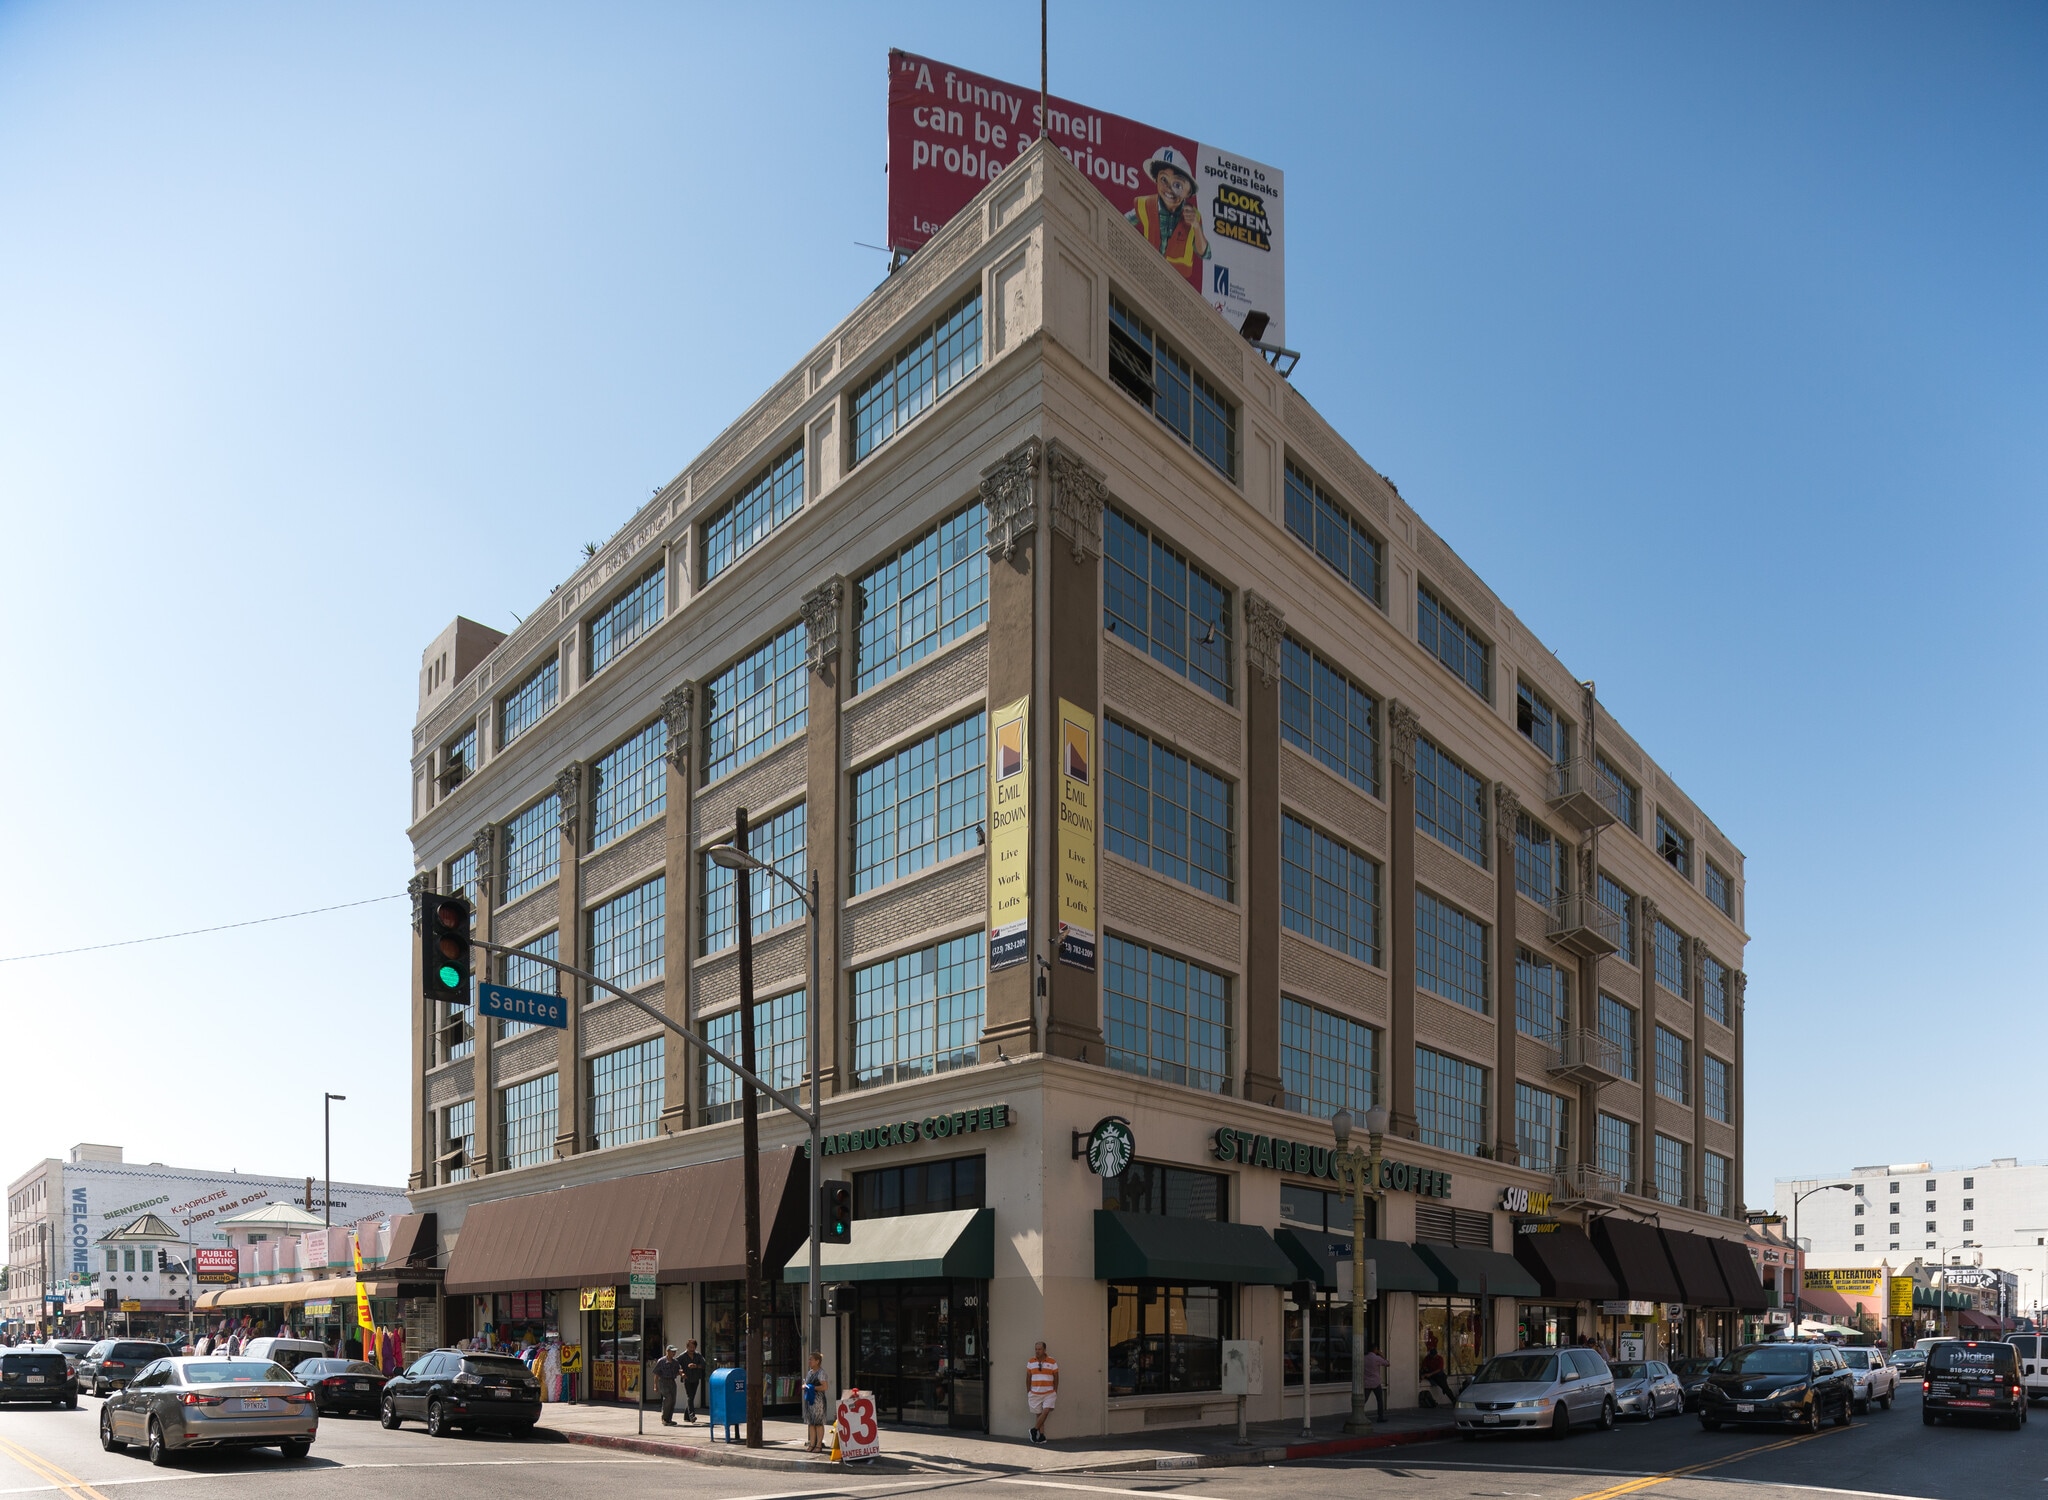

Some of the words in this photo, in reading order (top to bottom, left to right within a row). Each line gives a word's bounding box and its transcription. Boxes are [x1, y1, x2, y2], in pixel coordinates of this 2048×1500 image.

[945, 71, 1022, 125] funny
[1032, 104, 1102, 145] smell
[913, 106, 963, 137] can
[975, 111, 1008, 149] be
[1059, 146, 1140, 190] erious
[913, 139, 1010, 181] proble
[1204, 165, 1228, 180] spot
[1230, 173, 1249, 188] gas
[1250, 179, 1279, 198] leaks
[1218, 156, 1250, 176] Learn
[1254, 168, 1266, 182] to
[1220, 188, 1265, 216] LOOK.
[913, 215, 942, 235] Lea
[1214, 202, 1270, 235] LISTEN.
[1216, 219, 1269, 251] SMELL.
[999, 784, 1020, 805] EMIL
[1066, 780, 1088, 808] EMIL
[994, 805, 1026, 830] BROWN
[1060, 802, 1093, 832] BROWN
[1000, 849, 1019, 861] Live
[1068, 849, 1086, 864] Live
[998, 872, 1020, 886] Work
[1066, 872, 1088, 889] Work
[998, 897, 1020, 911] Lofts
[1066, 897, 1088, 912] Lofts
[489, 991, 558, 1019] Santee
[922, 1103, 1008, 1141] COFFEE
[1379, 1159, 1453, 1199] COFFEE
[103, 1195, 170, 1220] BIENVENIDOS
[182, 1209, 215, 1226] DOBRO
[218, 1201, 239, 1213] NAM
[241, 1190, 268, 1205] DOSLI
[1503, 1187, 1552, 1216] SUBWAY
[72, 1187, 88, 1273] WELCOME
[1518, 1223, 1560, 1234] SUBWAY
[1750, 1217, 1777, 1225] SUBWAY
[1804, 1270, 1831, 1281] SANTEE
[1833, 1269, 1882, 1280] ALTERATIONS
[964, 1296, 978, 1306] 300
[1949, 1367, 1995, 1375] 818-475-7675
[863, 1446, 879, 1456] ALLEY
